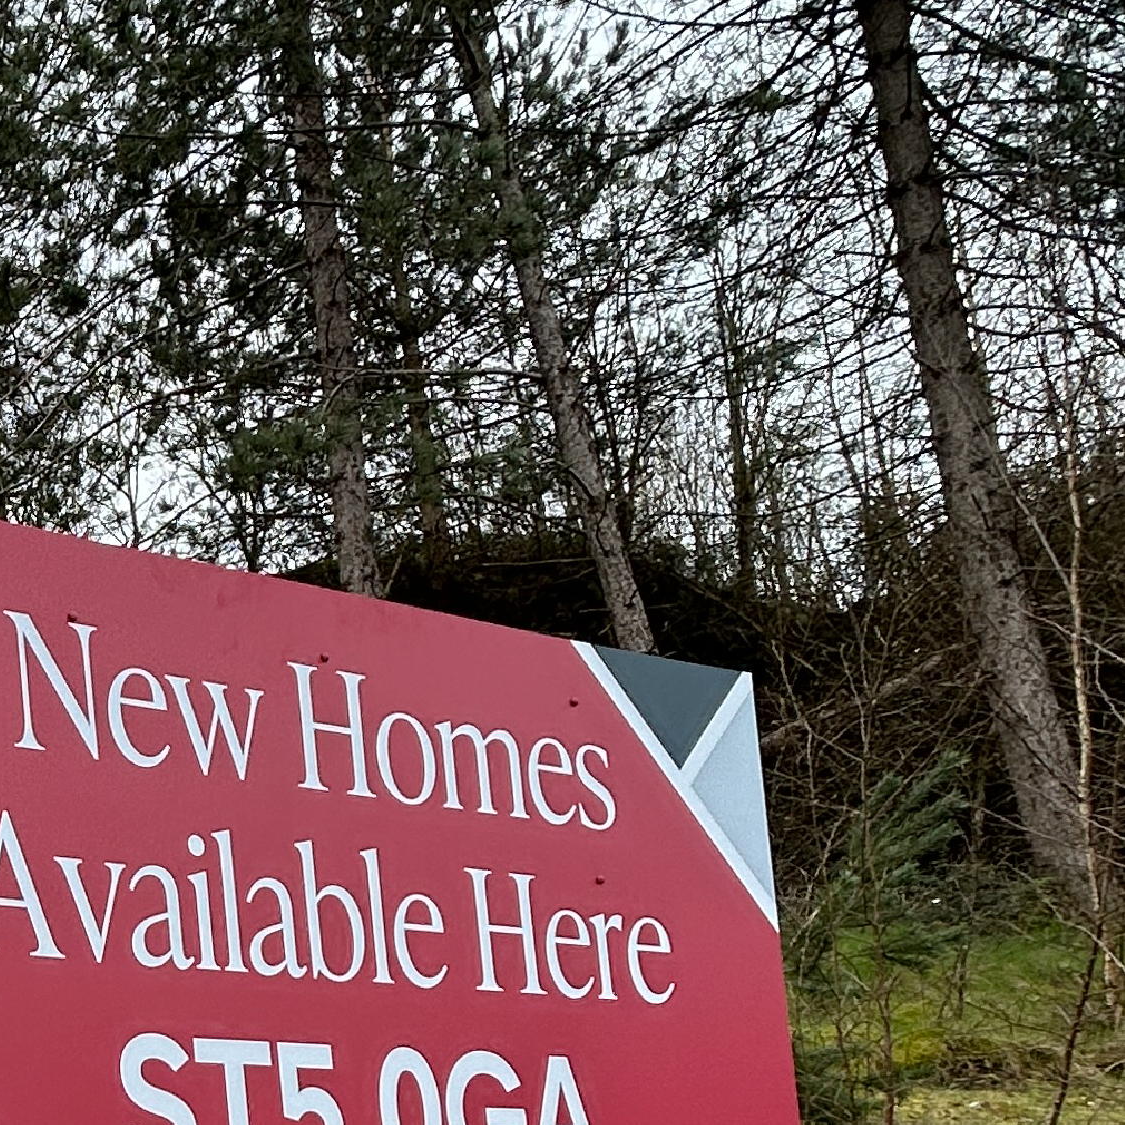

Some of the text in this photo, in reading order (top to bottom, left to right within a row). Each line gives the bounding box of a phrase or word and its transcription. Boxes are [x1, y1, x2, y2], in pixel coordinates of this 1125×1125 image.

[2, 609, 617, 831] New Homes
[463, 866, 676, 1005] Here
